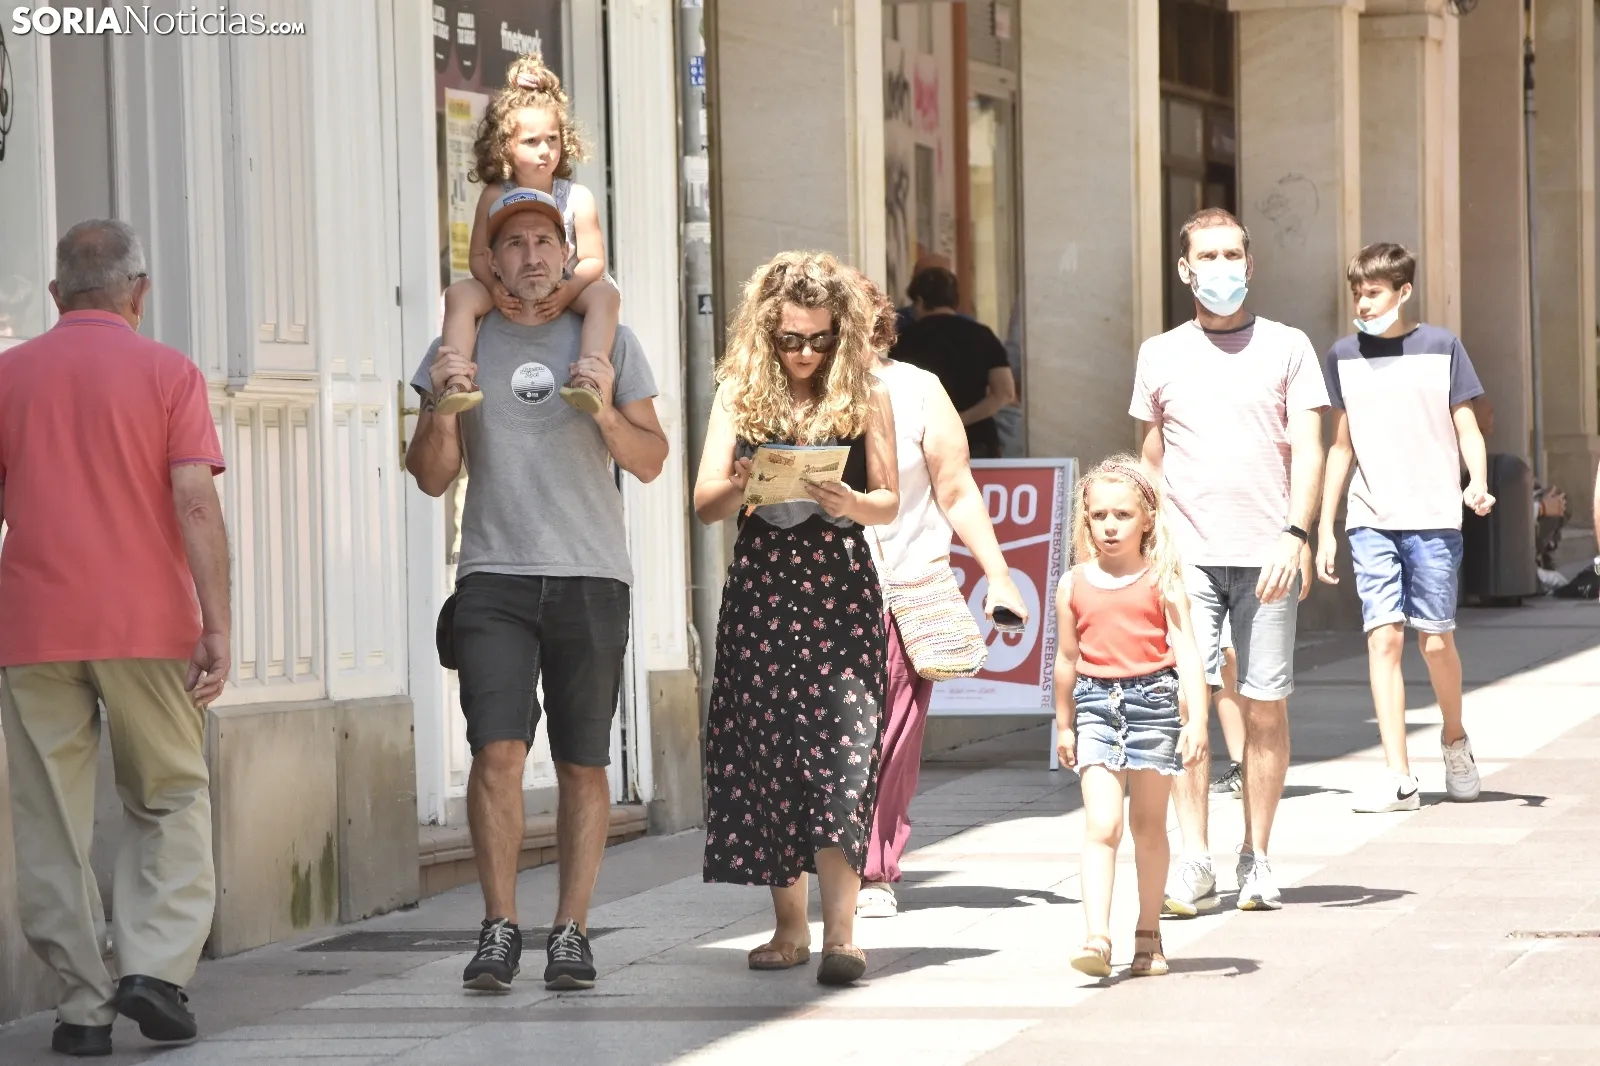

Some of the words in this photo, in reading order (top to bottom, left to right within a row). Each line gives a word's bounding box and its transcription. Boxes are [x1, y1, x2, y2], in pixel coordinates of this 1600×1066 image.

[1051, 523, 1062, 577] REBAJAS
[1046, 580, 1058, 634] REBAJAS
[1042, 637, 1055, 692] REBAJAS
